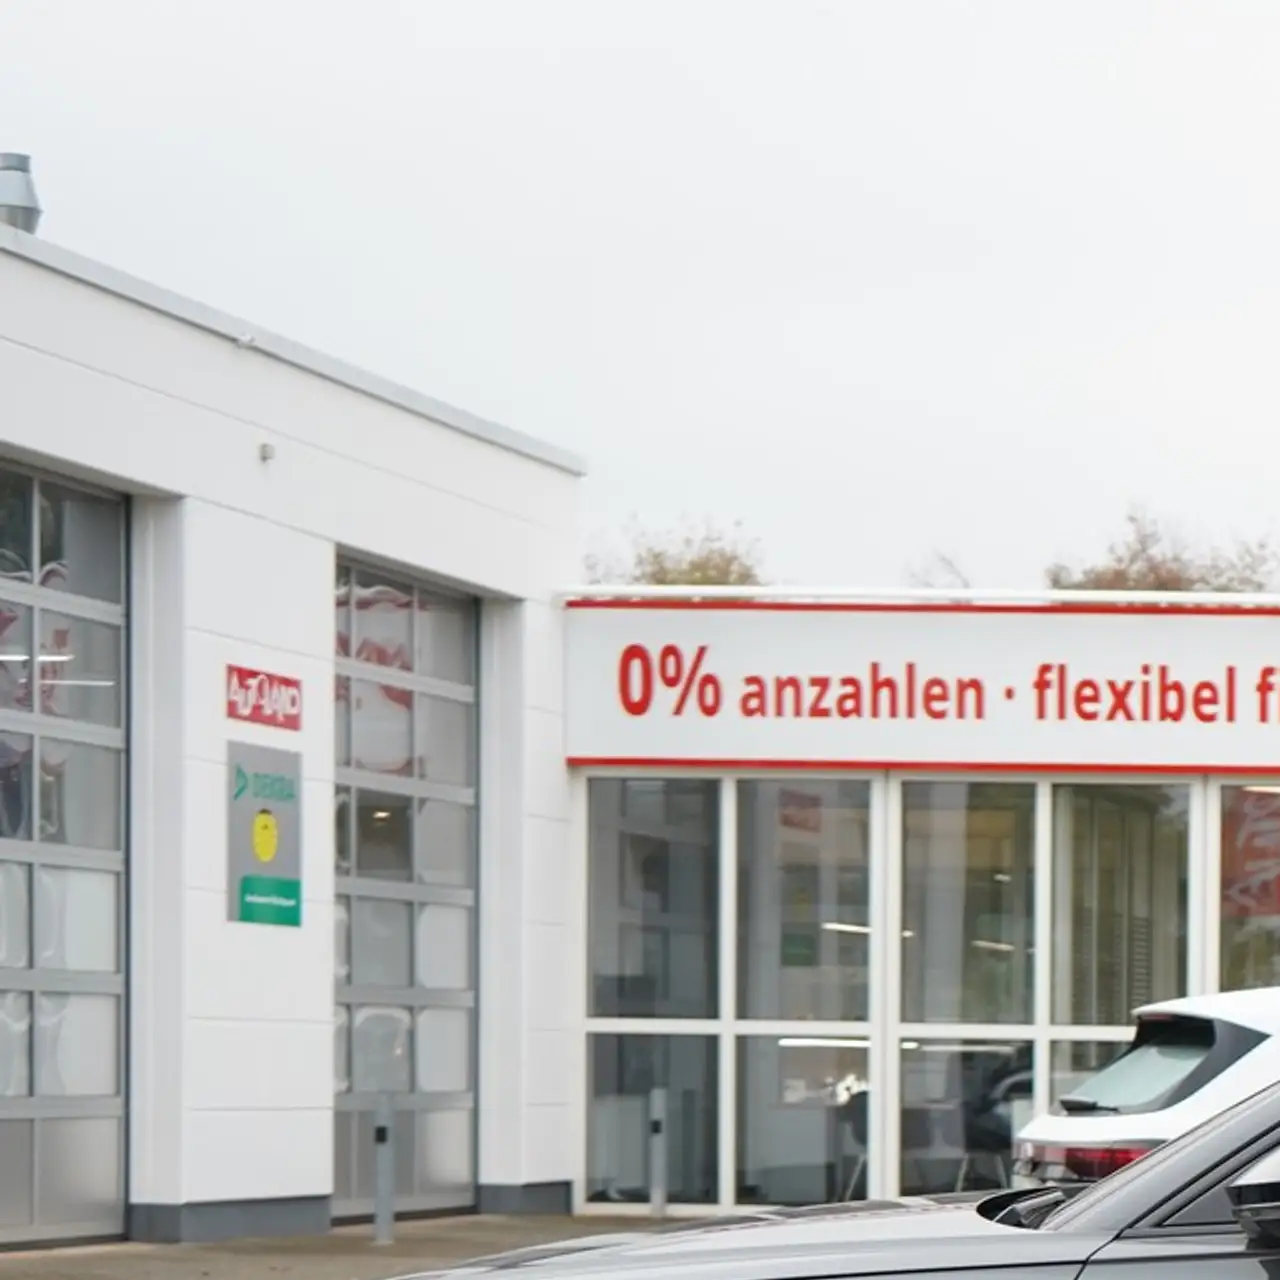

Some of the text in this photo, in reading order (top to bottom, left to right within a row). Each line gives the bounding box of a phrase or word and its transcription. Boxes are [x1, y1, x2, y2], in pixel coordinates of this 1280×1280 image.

[618, 643, 722, 717] 0%
[740, 663, 985, 720] anzahlen
[1033, 664, 1236, 722] flexibel
